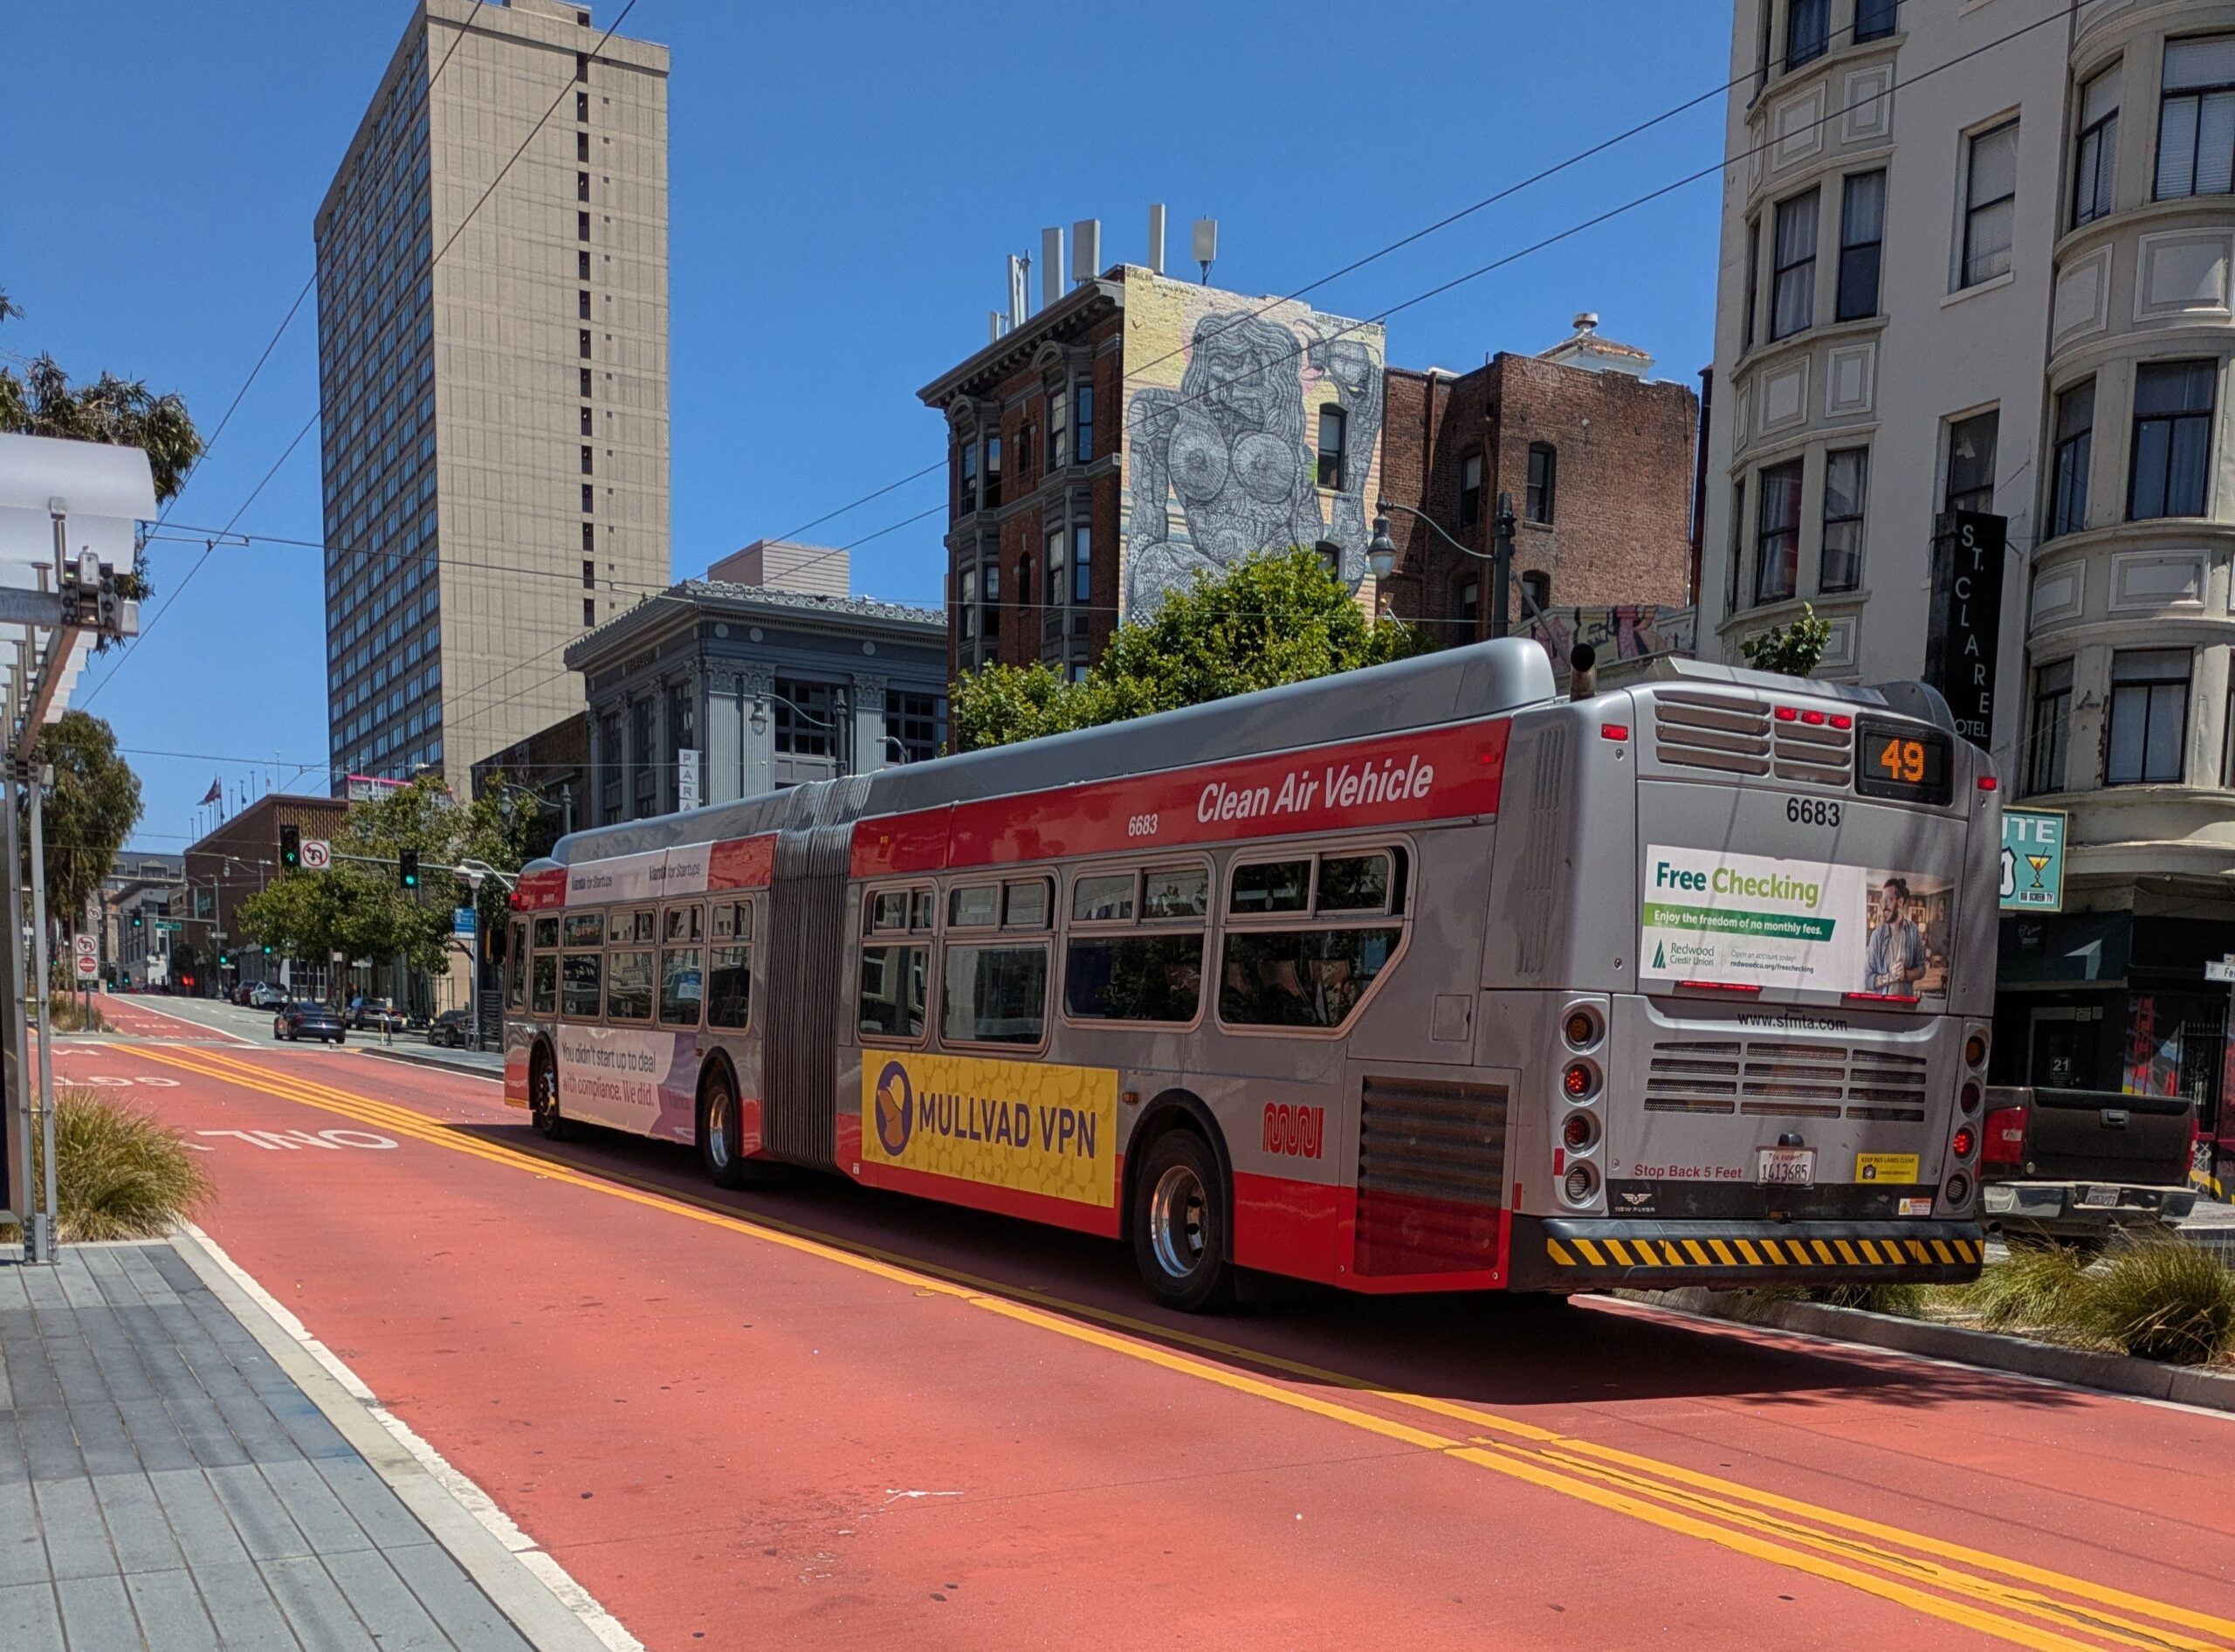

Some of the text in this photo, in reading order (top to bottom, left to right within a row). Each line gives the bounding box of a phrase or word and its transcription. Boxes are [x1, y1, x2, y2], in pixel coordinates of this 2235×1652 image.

[1955, 576, 1990, 713] CLARE
[1954, 718, 1988, 738] OTEL
[1881, 739, 1925, 782] 49
[1197, 754, 1434, 823] Clean Air Vehicle
[1786, 796, 1840, 828] 6683
[1128, 813, 1159, 837] 6683
[676, 862, 701, 878] Startups
[593, 875, 613, 889] Startups
[1656, 861, 1819, 909] Free Checking
[2046, 893, 2053, 902] TV
[1654, 910, 1822, 935] Enjoy the freedom of no monthly fees.
[1670, 942, 1715, 957] Redwood
[1731, 949, 1747, 960] Open
[1756, 952, 1778, 960] account
[1669, 955, 1714, 967] Credit Union
[1730, 960, 1814, 974] redwoodcu.org/freechecking
[1737, 1013, 1848, 1032] www.sfmta.com
[561, 1040, 656, 1075] You didn't start up to deal
[2053, 1058, 2069, 1072] 21
[562, 1071, 655, 1107] with compliance. We did.
[919, 1091, 1097, 1160] MULLVAD VPN
[1633, 1164, 1743, 1179] Stop Back 5 Feet
[1762, 1163, 1808, 1181] 1413685
